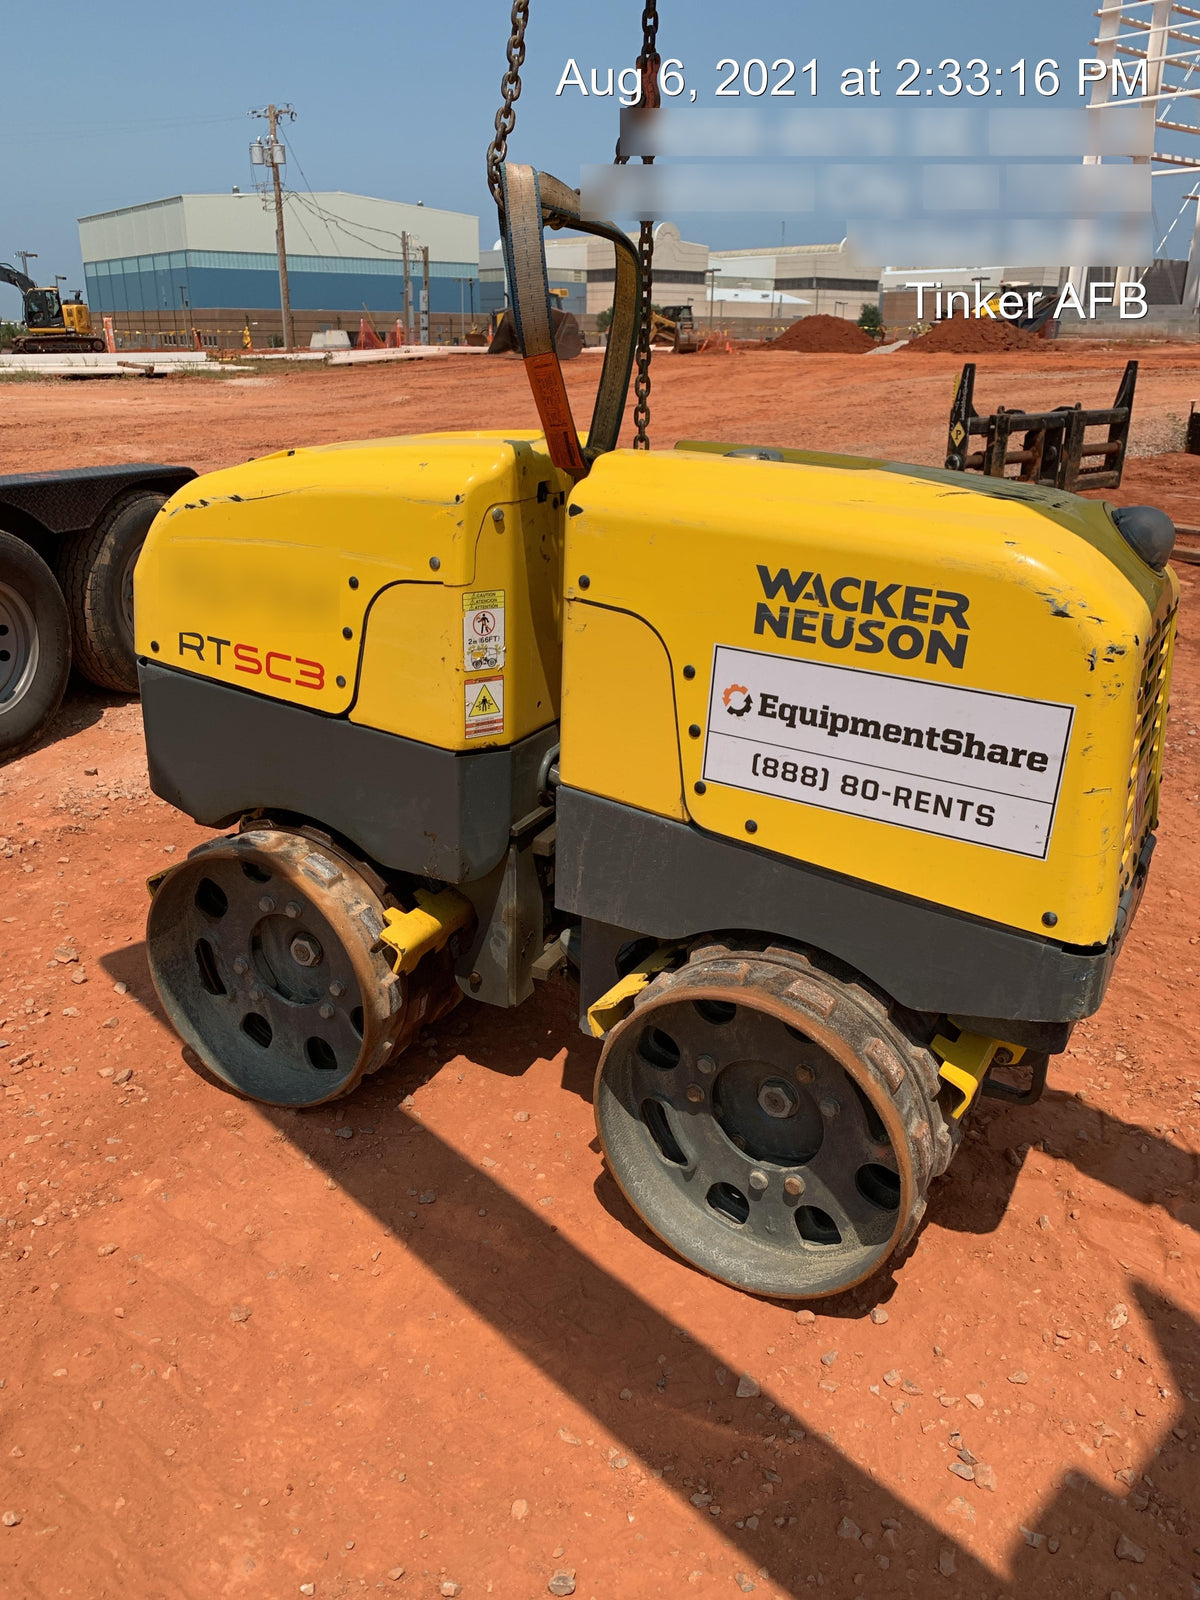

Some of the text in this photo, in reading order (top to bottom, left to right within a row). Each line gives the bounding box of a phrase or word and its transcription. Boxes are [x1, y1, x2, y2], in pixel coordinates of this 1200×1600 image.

[955, 429, 962, 440] P
[756, 564, 971, 631] WACKER
[753, 602, 969, 670] NEUSON
[757, 692, 1049, 774] EquipmentShare
[752, 753, 996, 828] (888) 80-RENTS
